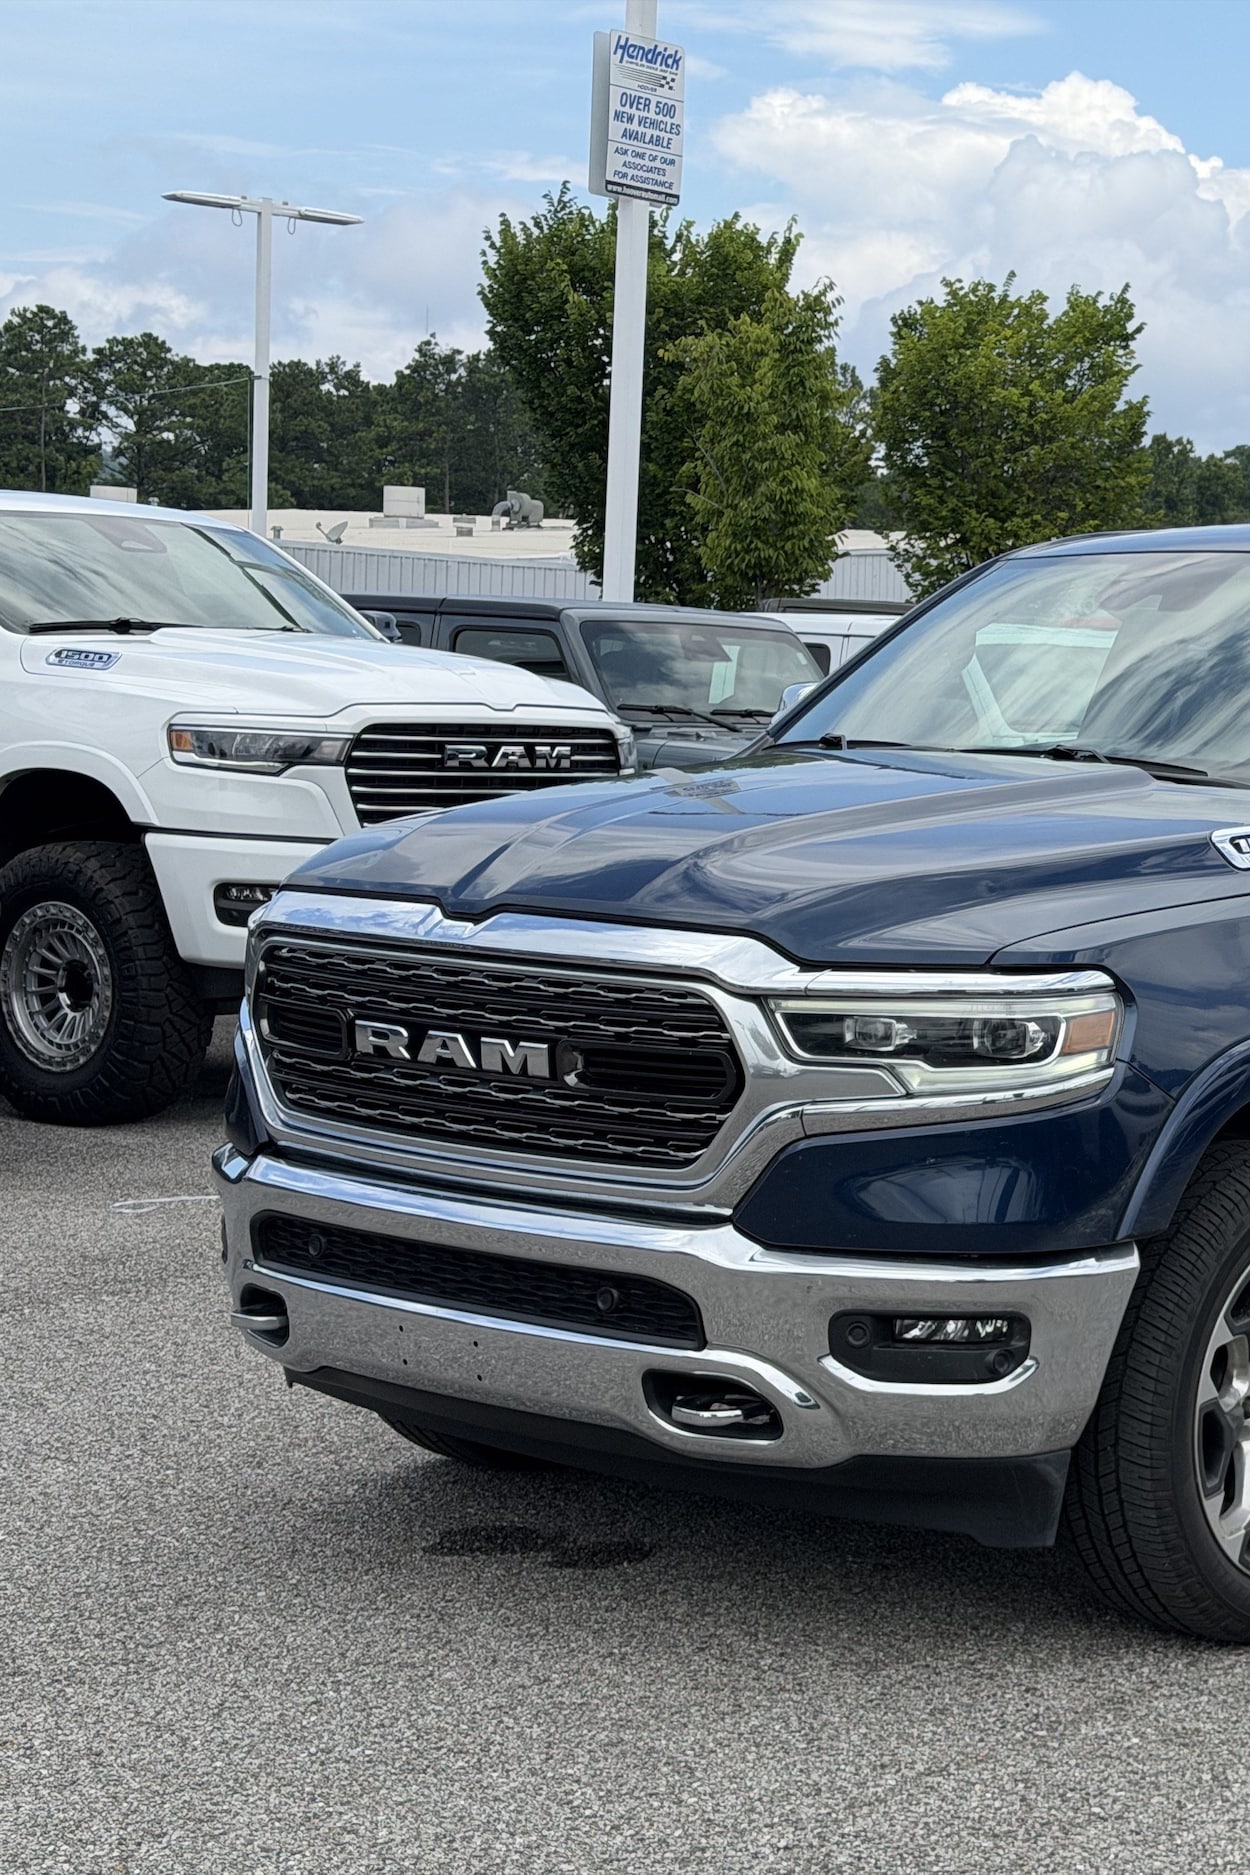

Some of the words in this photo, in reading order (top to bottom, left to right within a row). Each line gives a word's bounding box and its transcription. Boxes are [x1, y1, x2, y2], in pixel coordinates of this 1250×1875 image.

[613, 34, 682, 71] Hendrick
[620, 92, 651, 114] OVER
[654, 101, 677, 119] 500
[613, 109, 635, 125] NEW
[637, 114, 681, 136] VEHICLES
[621, 127, 673, 149] AVAILABLE
[614, 146, 629, 158] ASK
[631, 150, 647, 160] ONE
[648, 153, 659, 163] OF
[660, 156, 676, 167] OUR
[613, 170, 629, 180] FOR
[629, 173, 674, 190] ASSISTANCE
[622, 160, 667, 177] ASSOCIATES
[60, 650, 110, 663] 1500
[444, 744, 572, 769] RAM
[354, 1019, 550, 1079] RAM
